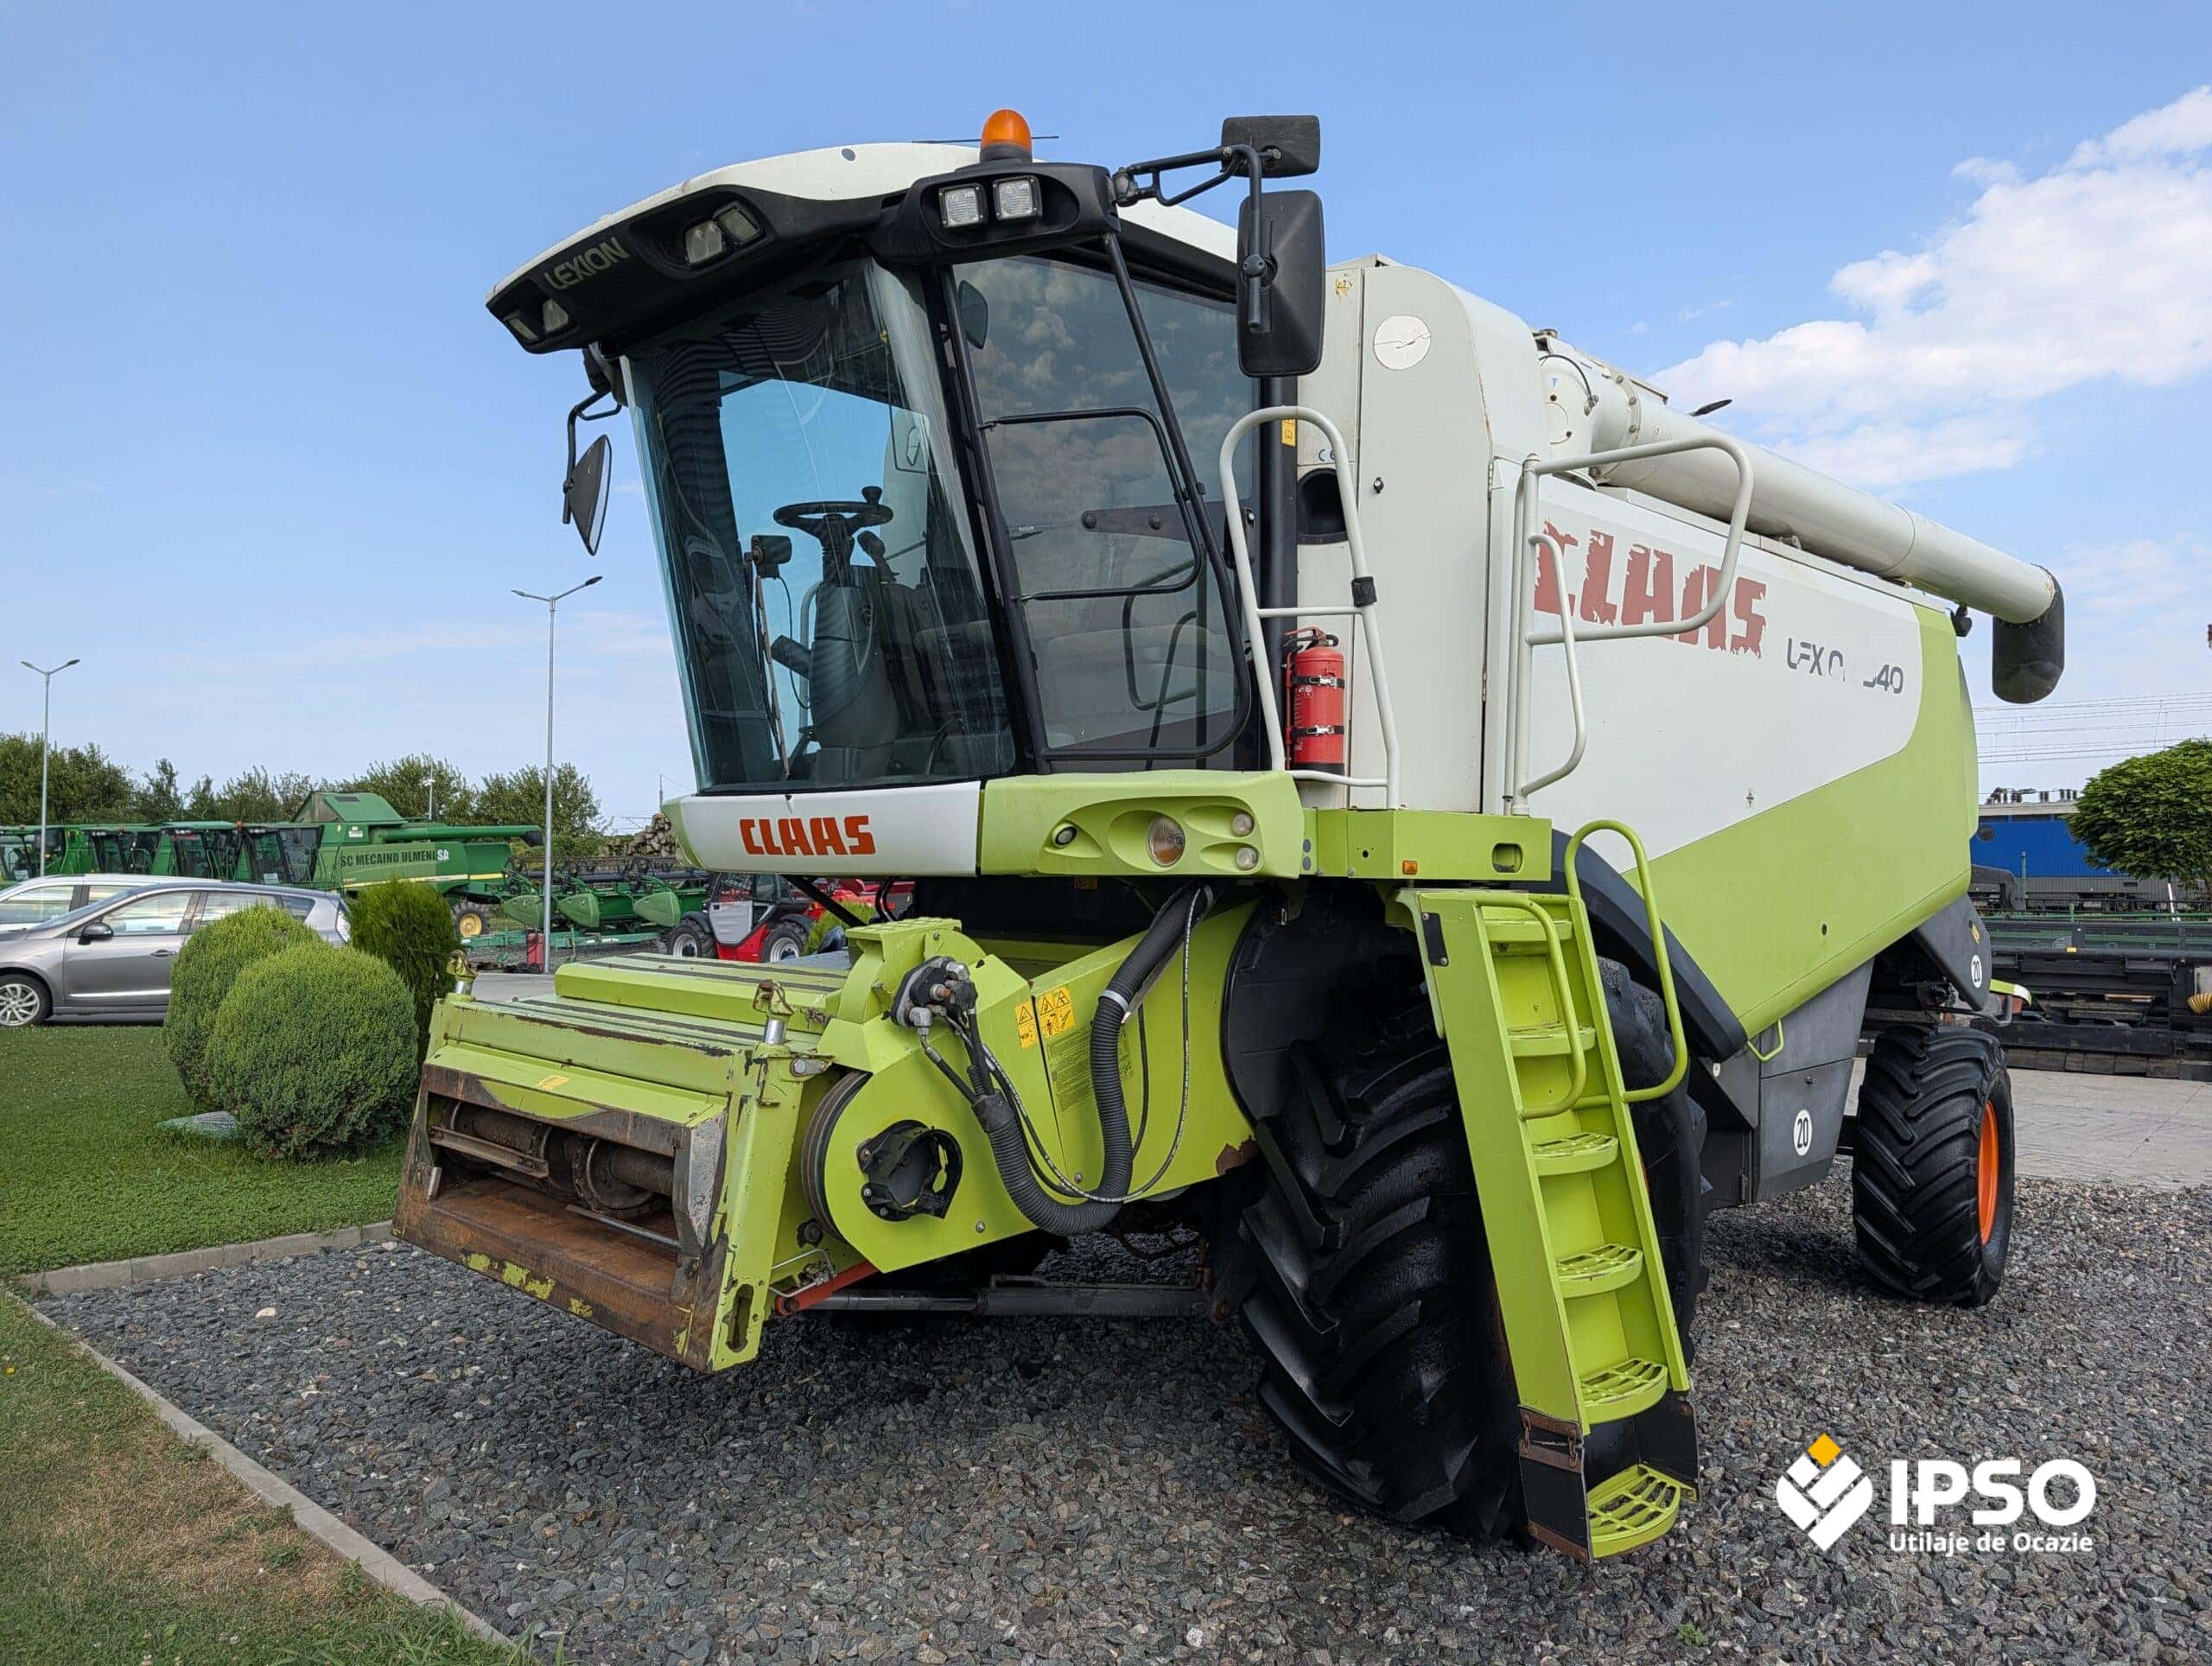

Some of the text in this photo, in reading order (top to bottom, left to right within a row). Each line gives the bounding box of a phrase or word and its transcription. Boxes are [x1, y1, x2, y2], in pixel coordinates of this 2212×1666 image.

[544, 237, 630, 290] LEXION
[1535, 519, 1766, 658] CLAAS
[739, 815, 877, 856] CLAAS
[340, 855, 353, 868] SC
[402, 850, 435, 862] ULMENI
[436, 849, 449, 862] SA
[1797, 1117, 1808, 1149] 20
